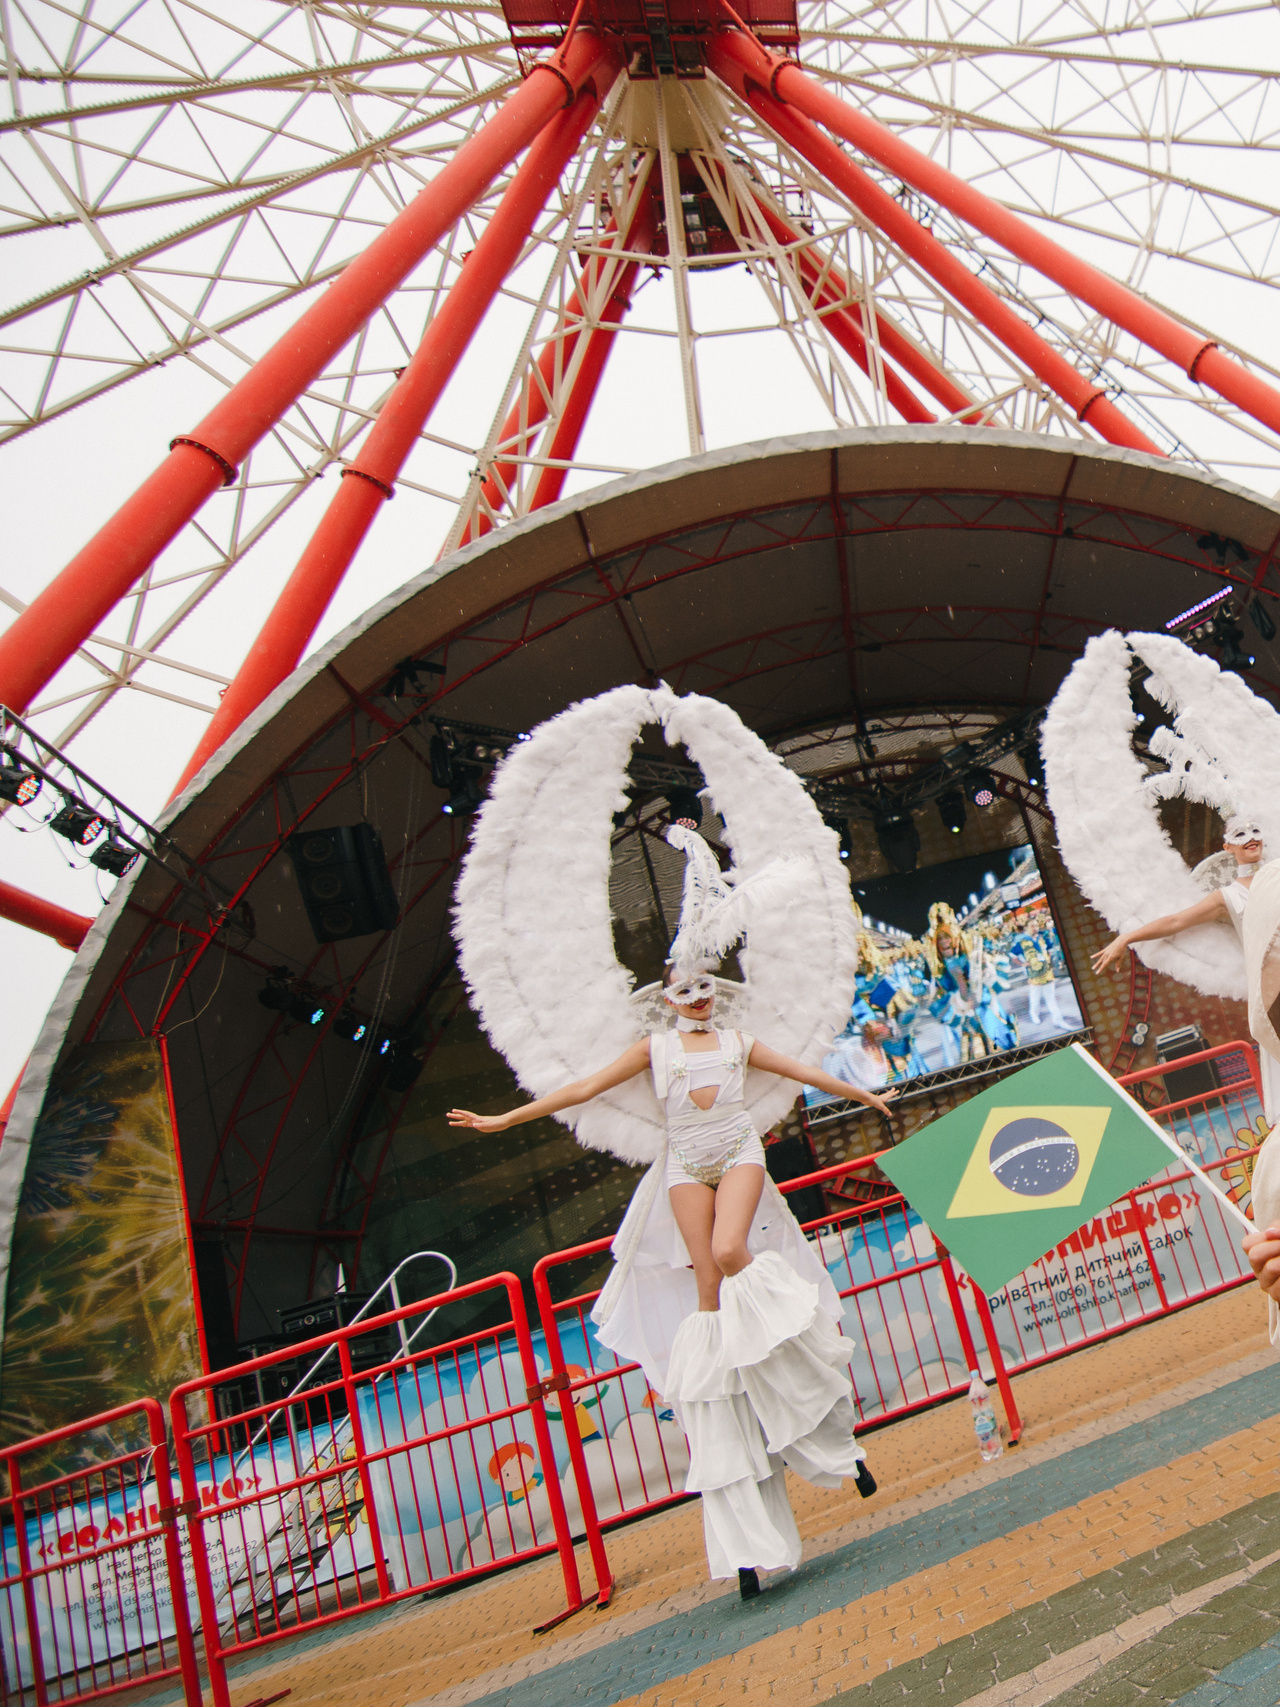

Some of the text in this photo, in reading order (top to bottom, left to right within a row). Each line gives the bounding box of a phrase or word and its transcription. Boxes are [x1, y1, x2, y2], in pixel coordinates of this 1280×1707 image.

[988, 1225, 1193, 1314] риватний дитячий садок
[1055, 1282, 1087, 1305] (096)
[1024, 1273, 1166, 1332] www.olnishko.kharkov.a
[38, 1476, 262, 1557] «СОЛНКО»
[85, 1589, 112, 1606] 057)
